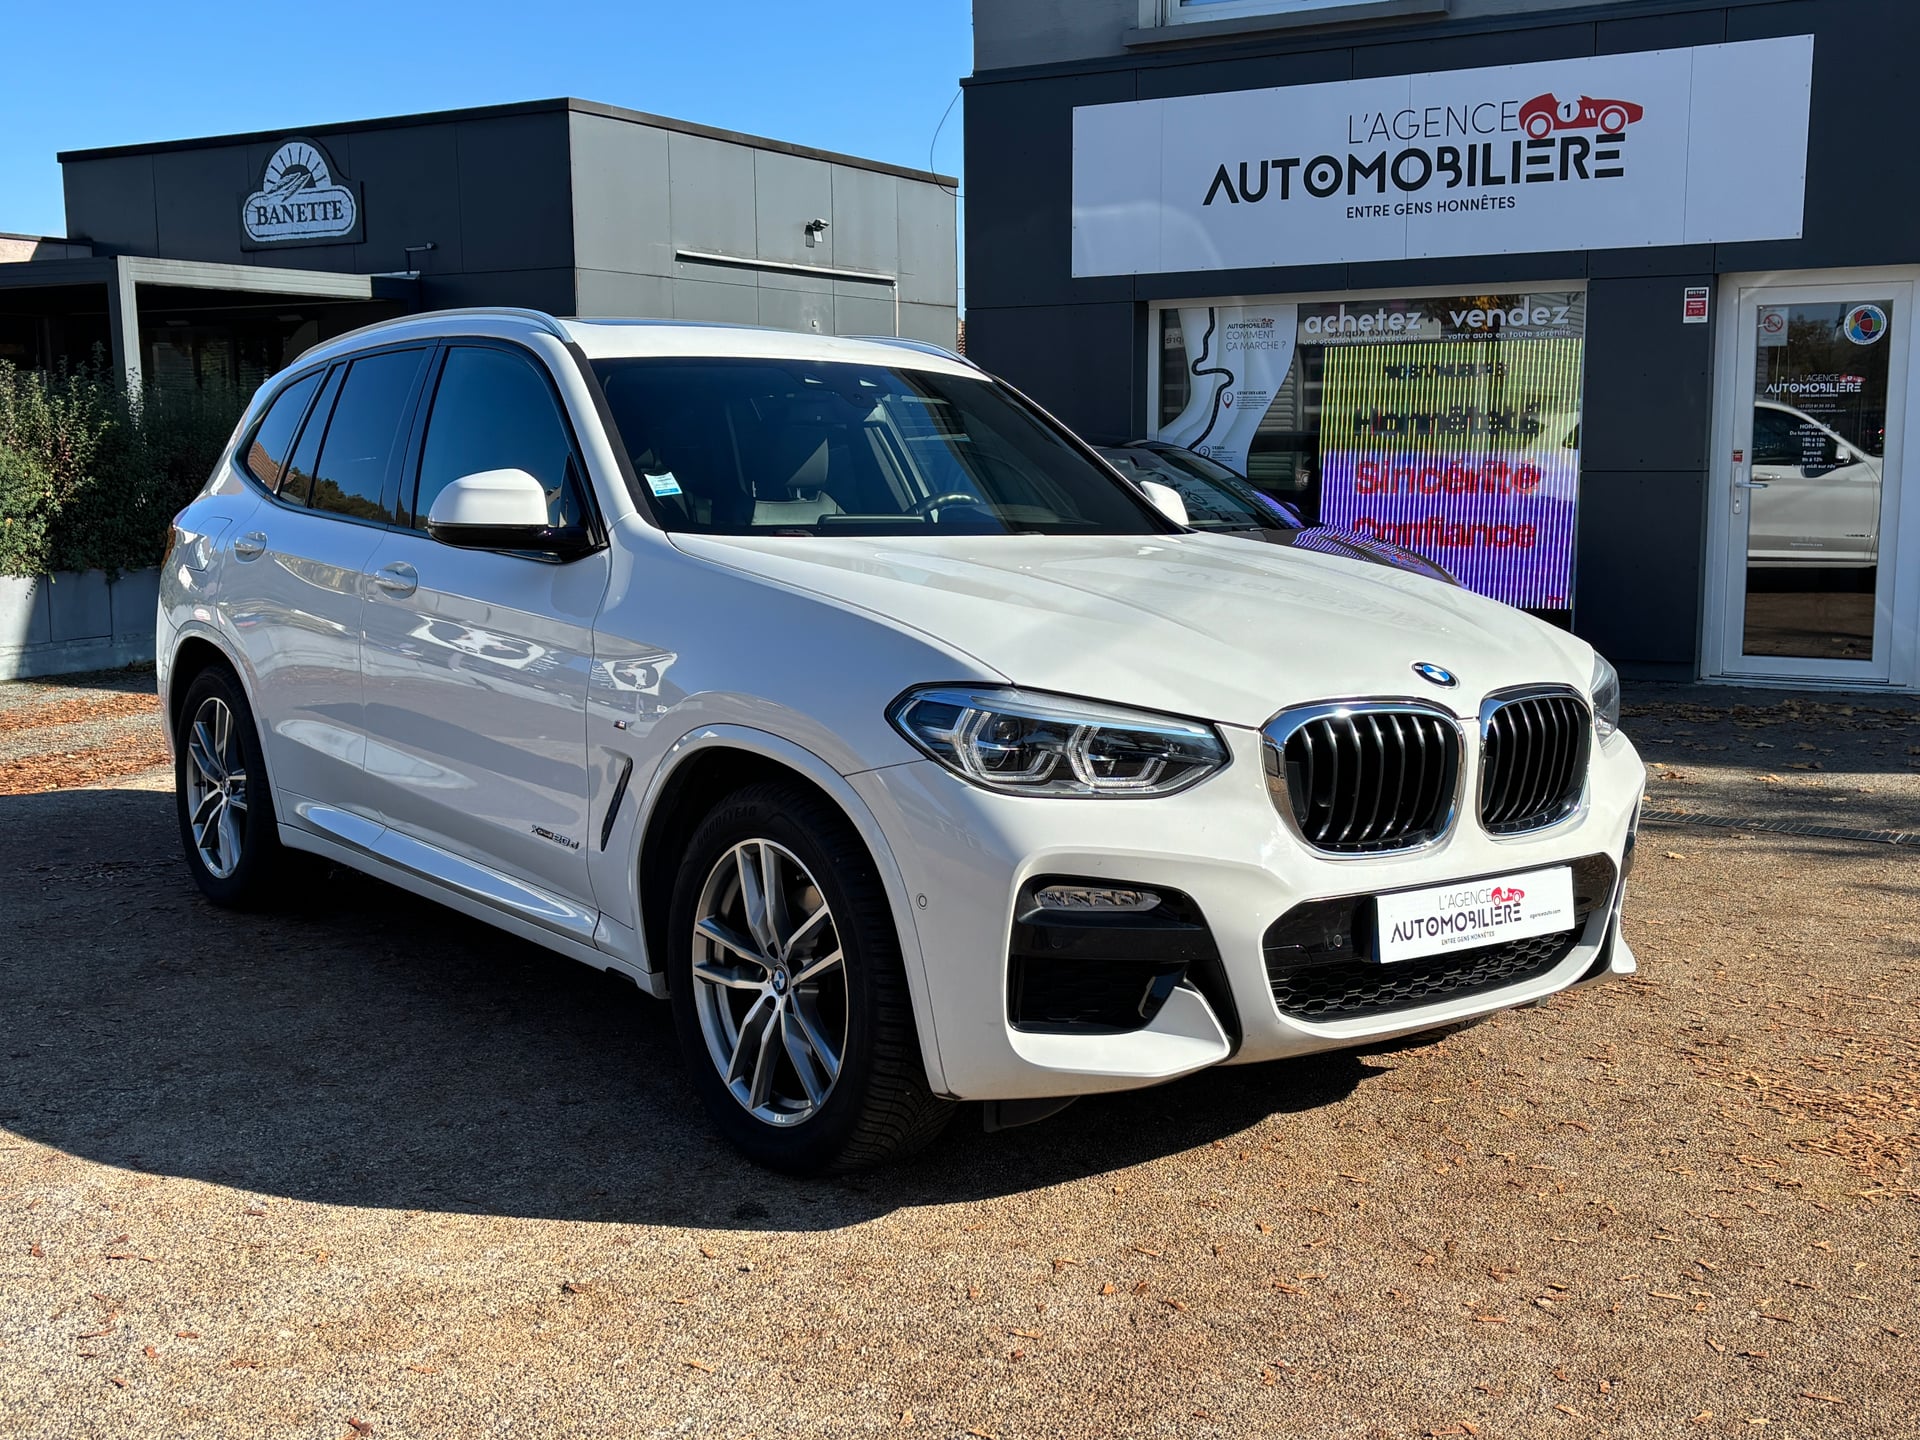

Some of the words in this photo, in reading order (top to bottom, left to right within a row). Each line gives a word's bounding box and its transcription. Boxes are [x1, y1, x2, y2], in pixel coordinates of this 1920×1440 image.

[1347, 100, 1519, 145] L'AGENCE
[1563, 103, 1571, 118] 1
[255, 200, 344, 226] BANETTE
[1346, 204, 1390, 219] ENTRE
[1394, 201, 1433, 216] GENS
[1437, 194, 1516, 213] HONNÊTES
[1304, 304, 1422, 333] achetez
[1449, 296, 1570, 328] vendez
[1226, 330, 1276, 340] COMMENT
[1226, 342, 1238, 352] ÇA
[1240, 341, 1279, 350] MARCHE
[1281, 341, 1287, 349] ?
[1800, 374, 1839, 382] L'AGENCE
[1438, 887, 1492, 911] L'AGENCE
[1441, 937, 1456, 946] ENTRE
[1457, 935, 1470, 944] GENS
